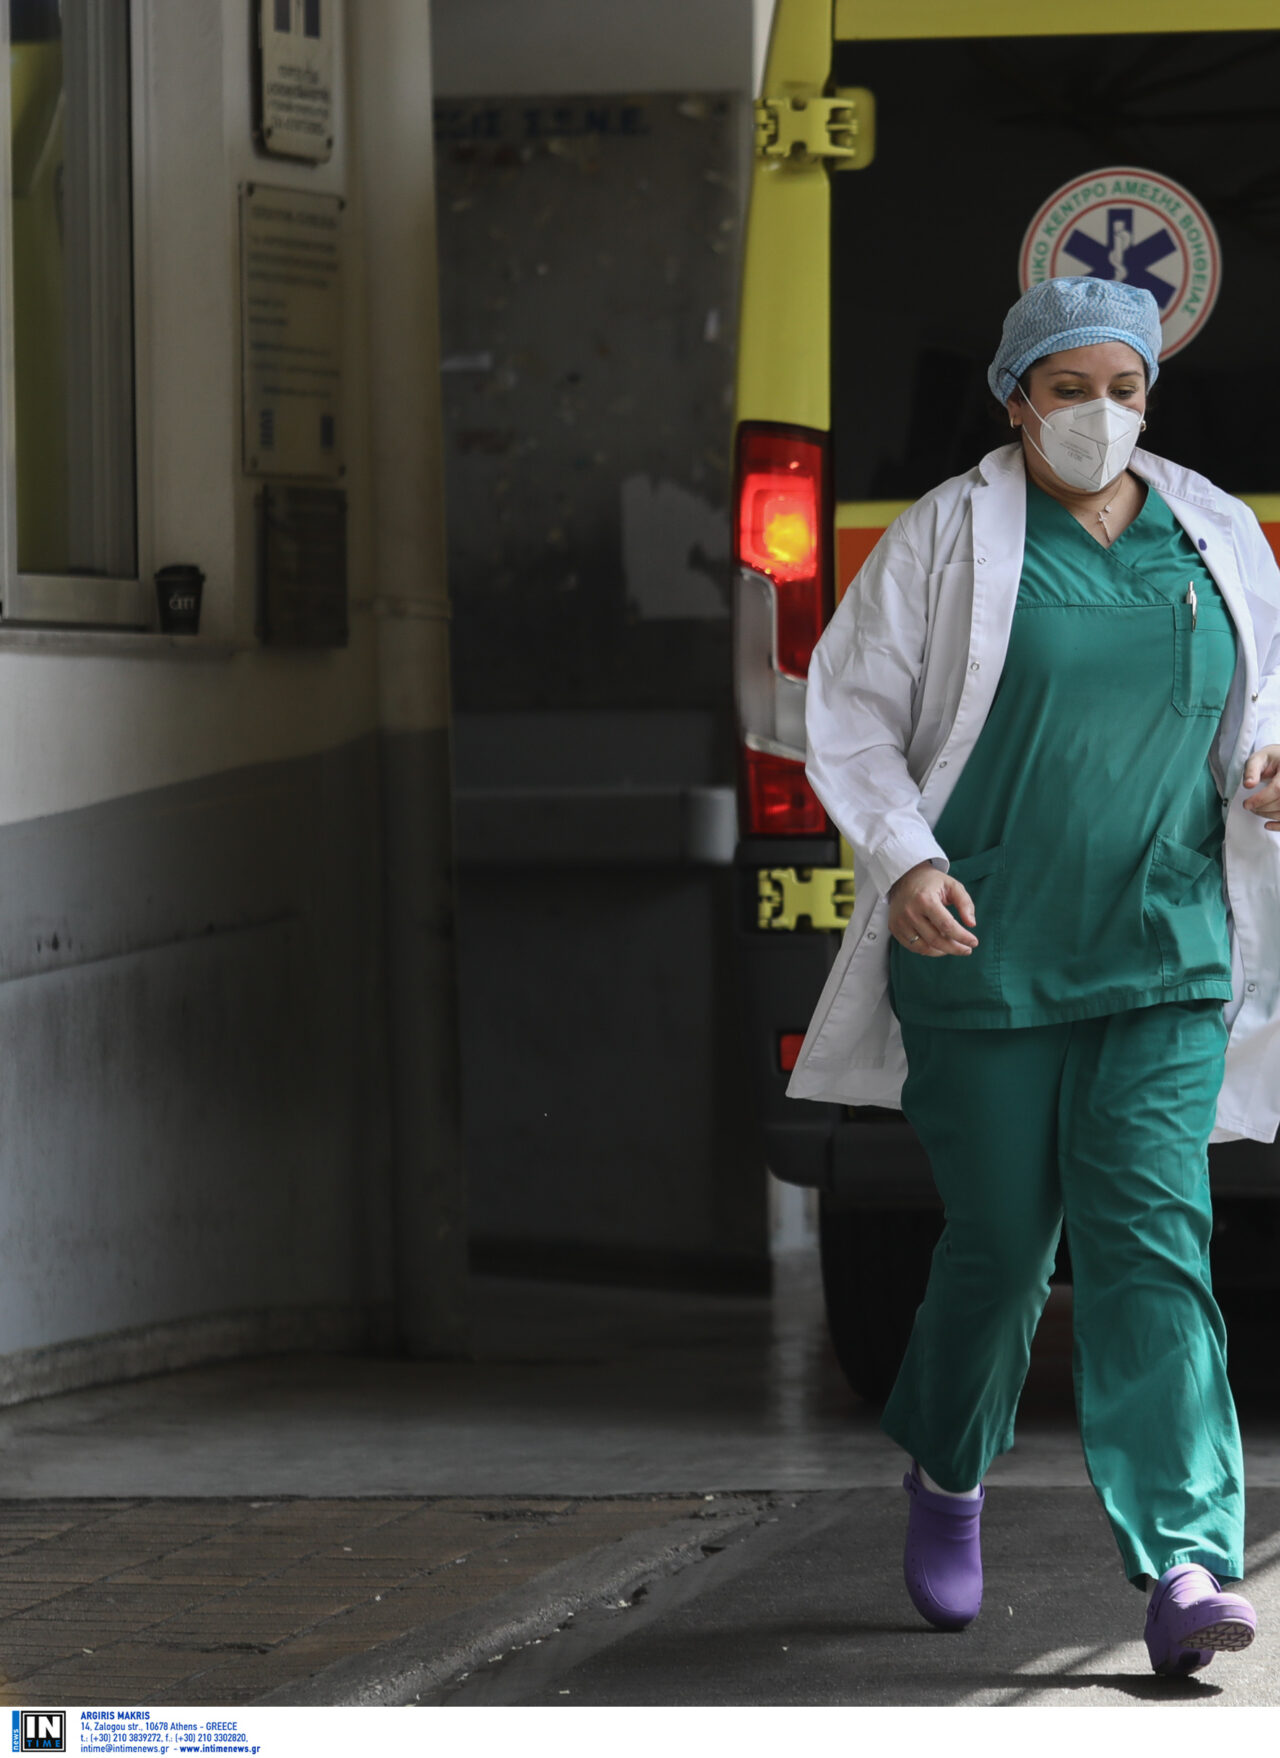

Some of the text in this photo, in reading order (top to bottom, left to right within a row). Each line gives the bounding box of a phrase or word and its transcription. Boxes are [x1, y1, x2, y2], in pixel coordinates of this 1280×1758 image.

[1044, 182, 1108, 238] ΚΕΝΤΡΟ
[1112, 180, 1185, 218] ΑΜΕΣΗΣ
[1178, 214, 1209, 318] ΒΟΗΘΕΙΑΣ
